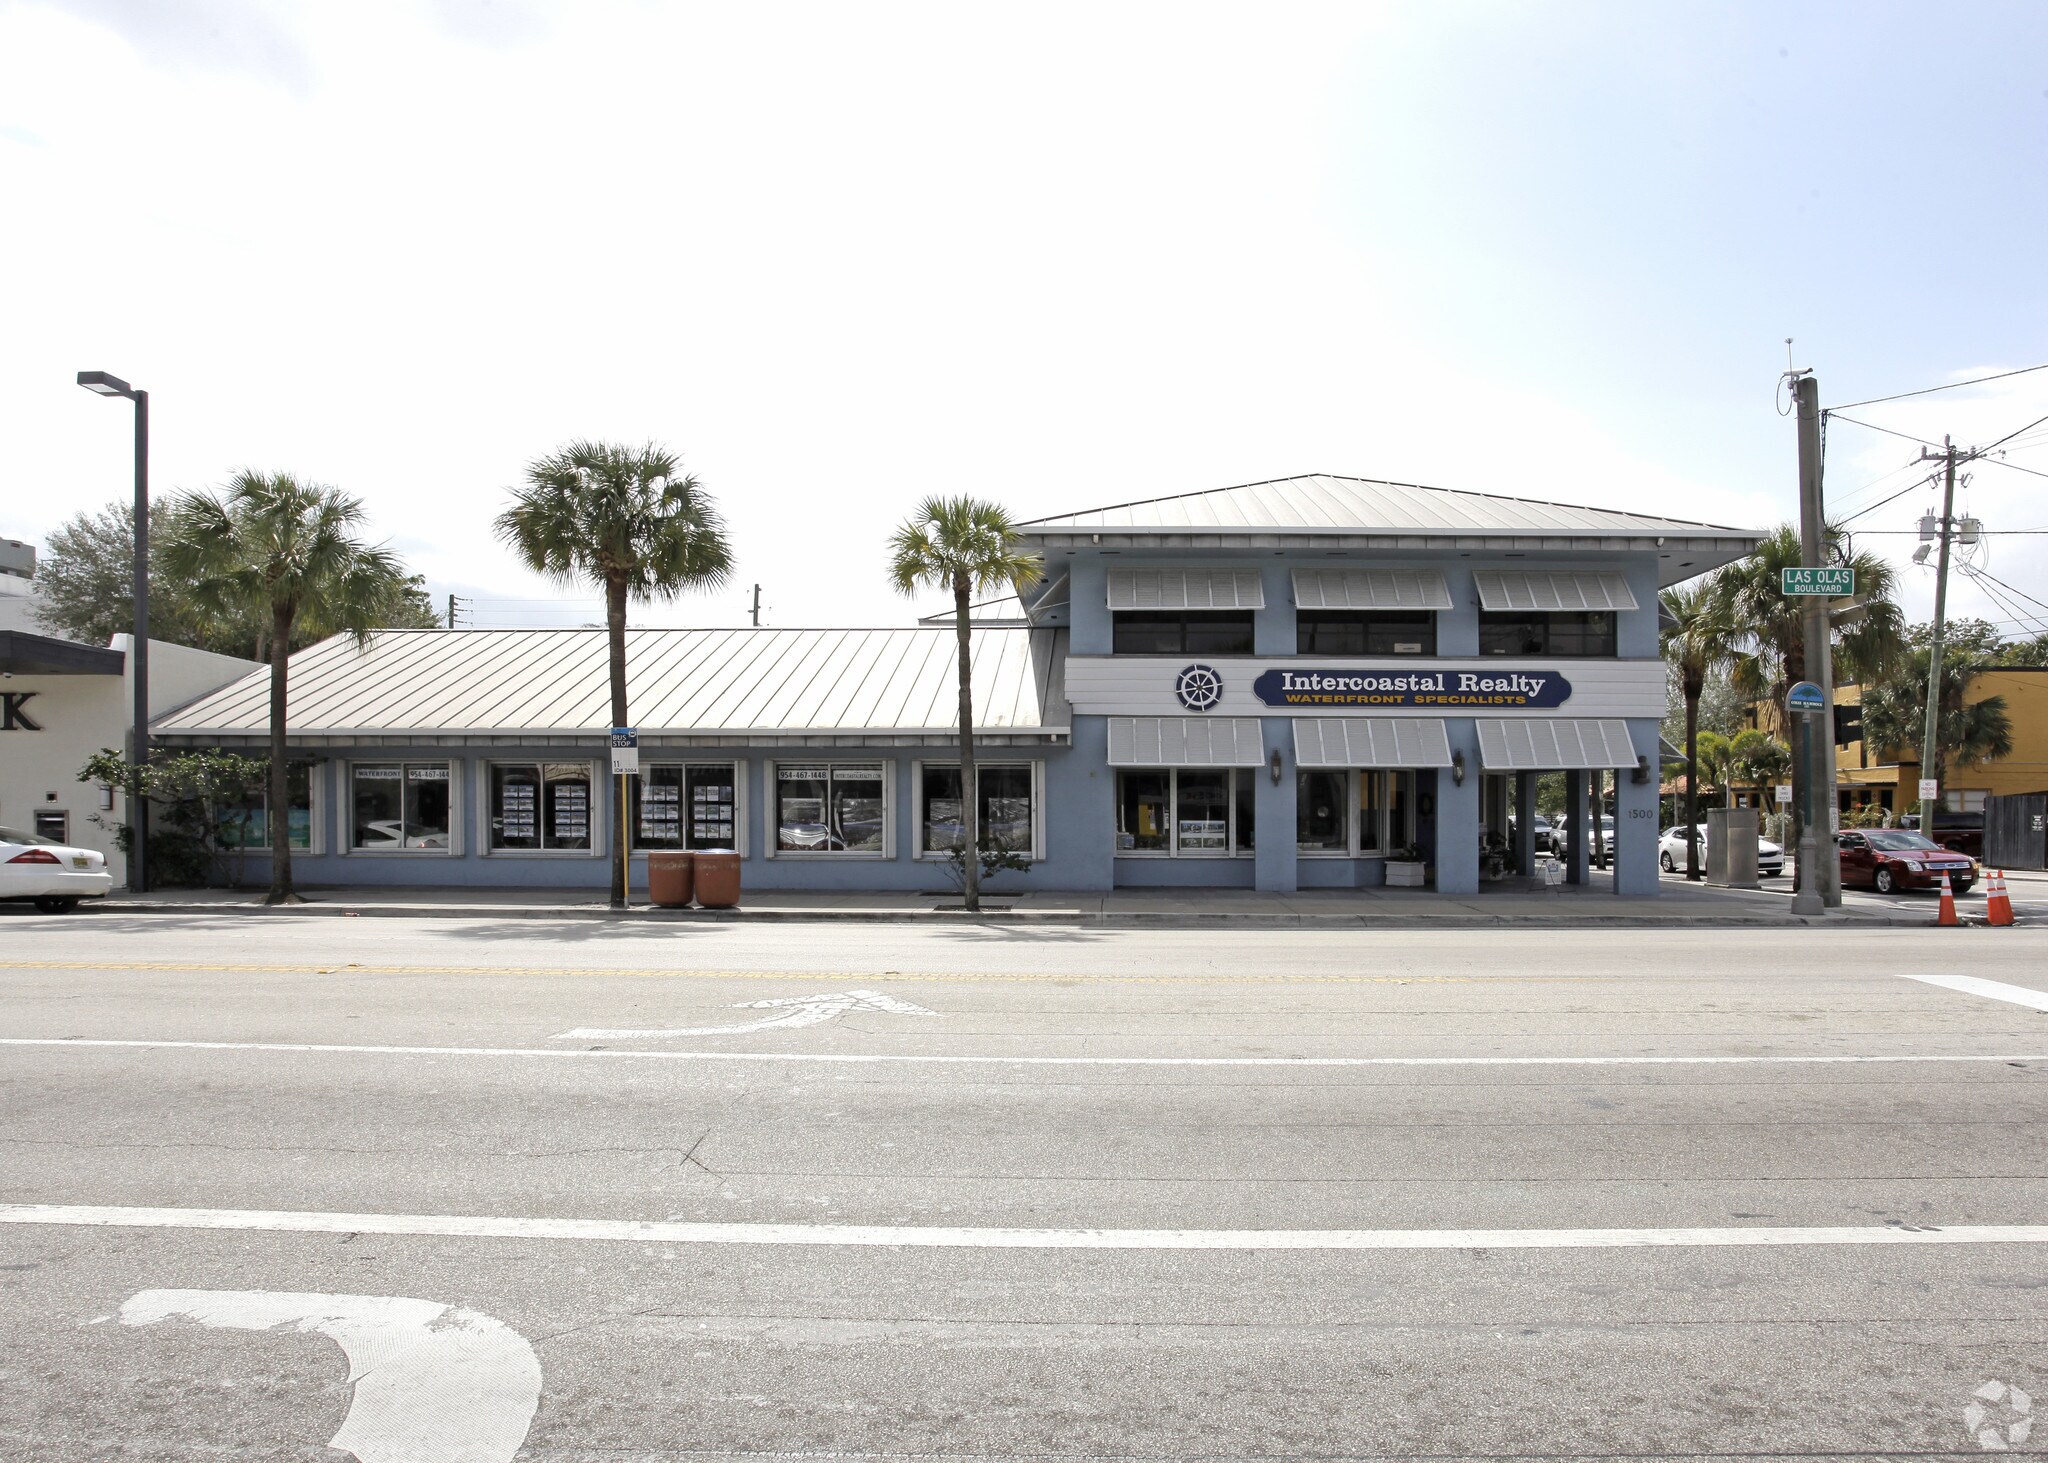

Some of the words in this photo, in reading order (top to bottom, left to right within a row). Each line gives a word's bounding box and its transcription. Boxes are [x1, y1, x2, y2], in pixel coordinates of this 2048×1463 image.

[1786, 570, 1811, 583] LAS
[1817, 570, 1850, 583] OLAS
[1794, 584, 1842, 592] BOULEVARD
[1281, 672, 1445, 691] Intercoastal
[1458, 673, 1546, 698] Realty
[1285, 694, 1405, 704] WATERFRONT
[1414, 695, 1527, 704] SPECIALISTS
[779, 771, 827, 779] 954-467-1448
[1628, 809, 1654, 819] 1500
